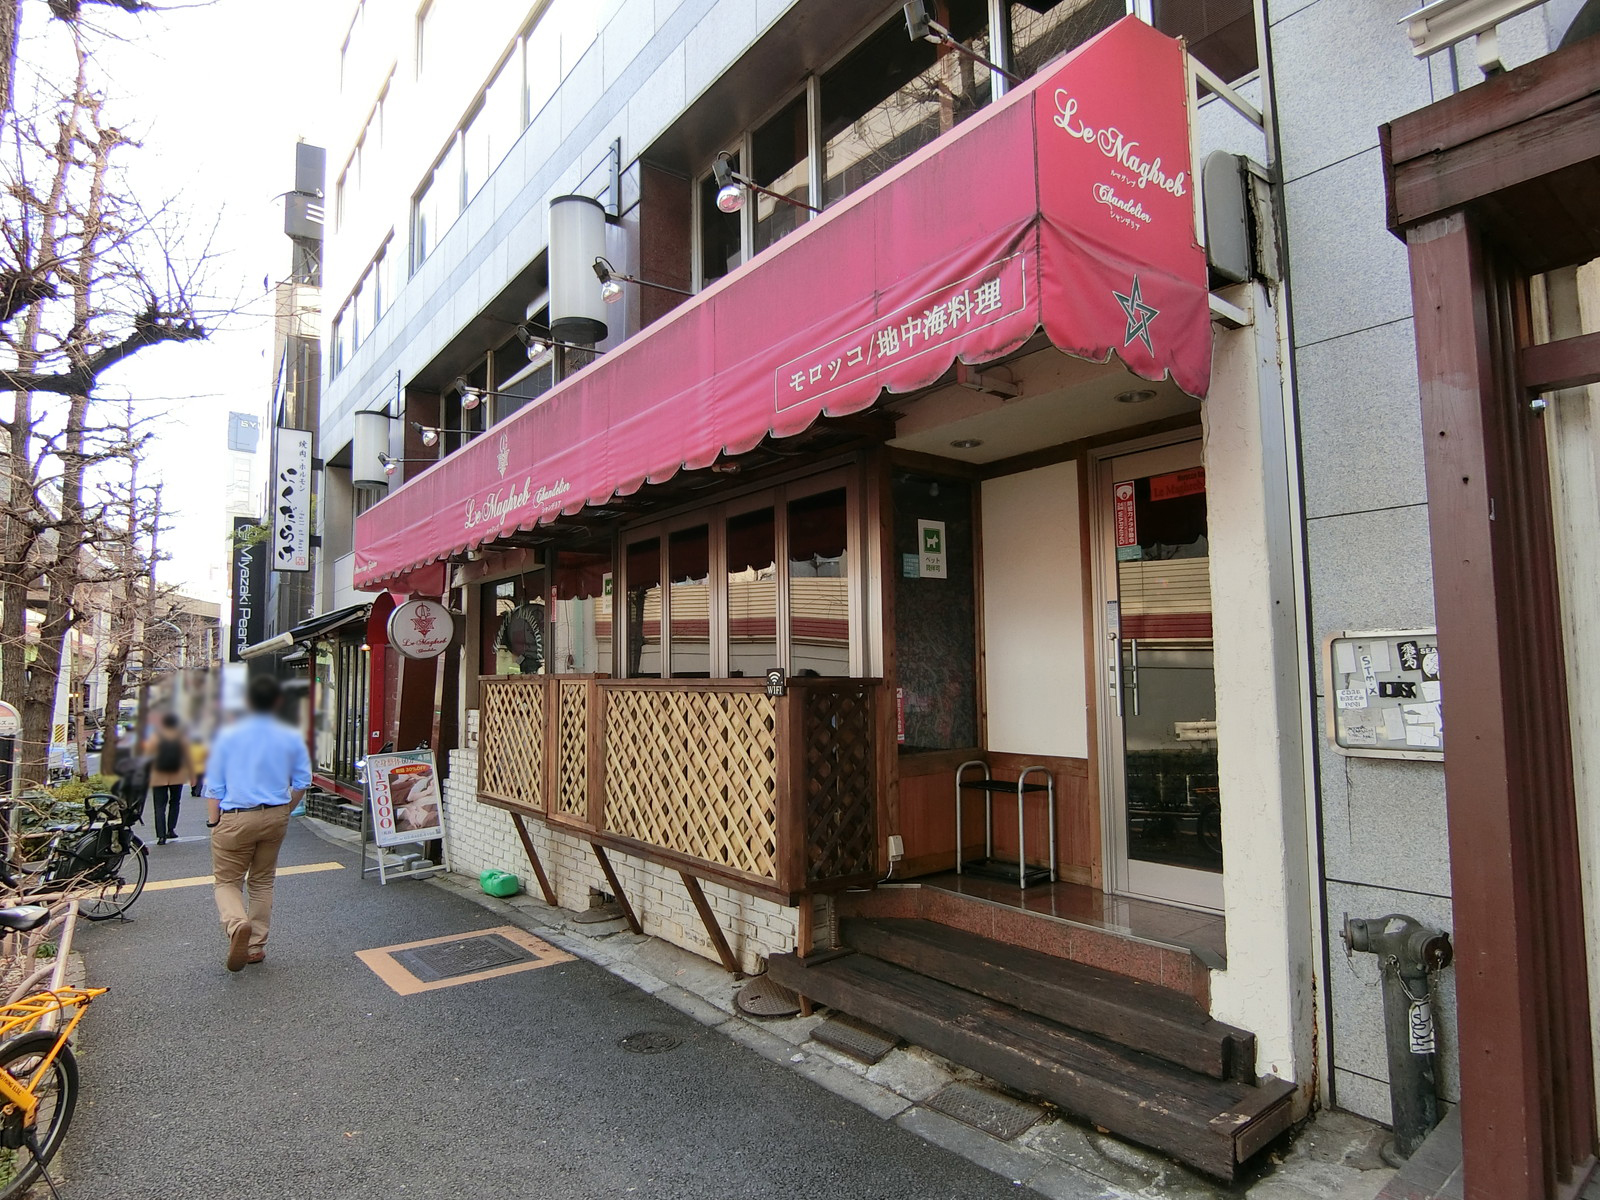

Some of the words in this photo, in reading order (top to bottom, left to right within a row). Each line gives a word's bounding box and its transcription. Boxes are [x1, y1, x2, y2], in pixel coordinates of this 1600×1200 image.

[1053, 88, 1095, 144] Le
[1097, 127, 1187, 197] Maghreb
[1093, 182, 1152, 224] Chandelier
[789, 277, 1002, 392] モロッコ/地中海料理
[278, 467, 298, 563] にくだらけ
[464, 498, 482, 529] Le
[481, 476, 532, 526] Maghreb
[533, 477, 571, 509] Chandelier
[1117, 511, 1125, 545] WARNING
[237, 544, 253, 605] Miyazaki
[237, 607, 251, 656] Pearls
[767, 685, 782, 695] WIFI
